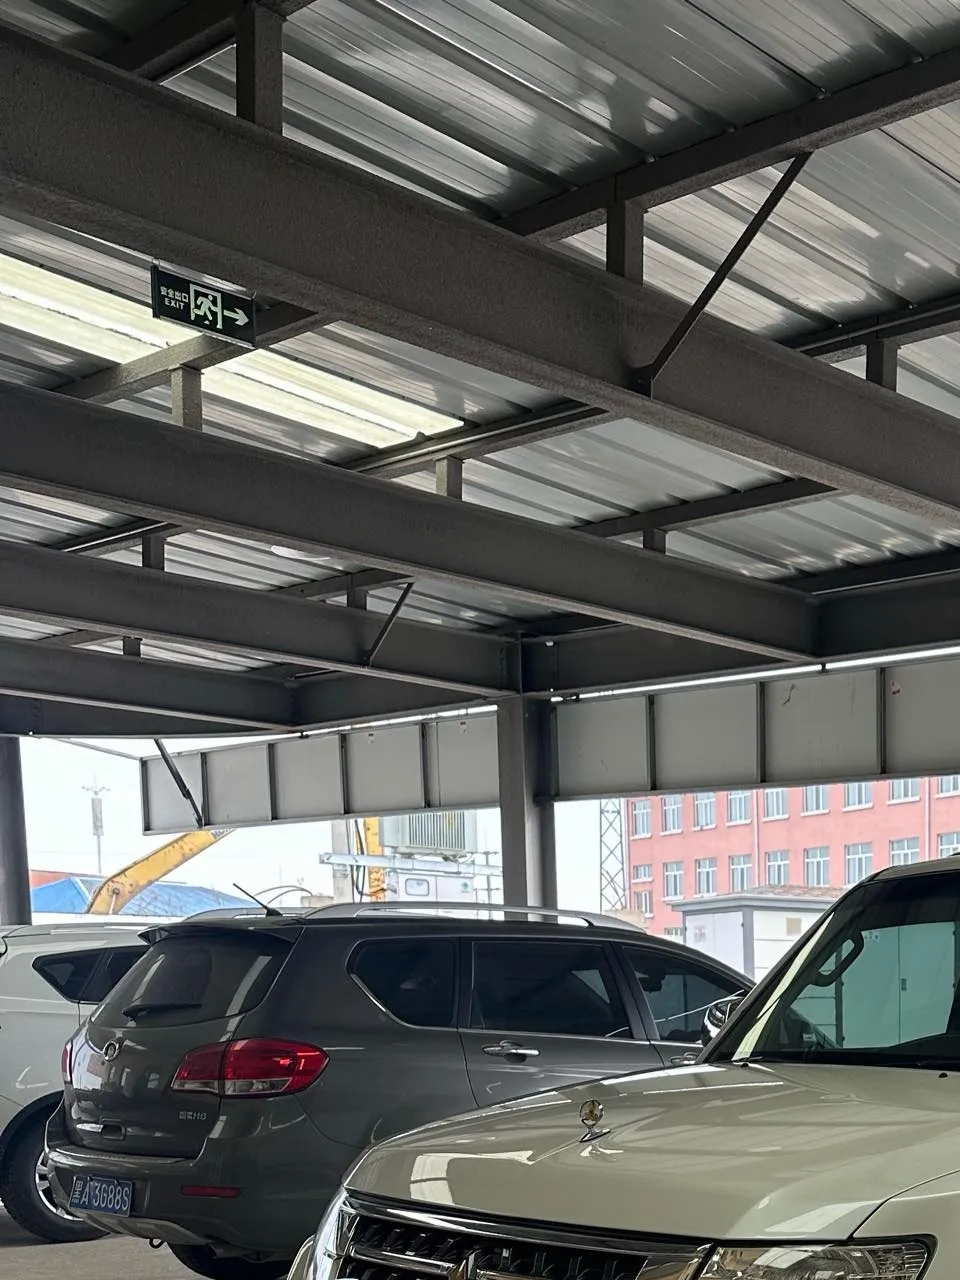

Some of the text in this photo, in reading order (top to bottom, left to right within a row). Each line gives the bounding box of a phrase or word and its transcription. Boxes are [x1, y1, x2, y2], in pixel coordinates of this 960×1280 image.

[160, 286, 189, 302] 安全出口
[164, 298, 185, 310] EXIT
